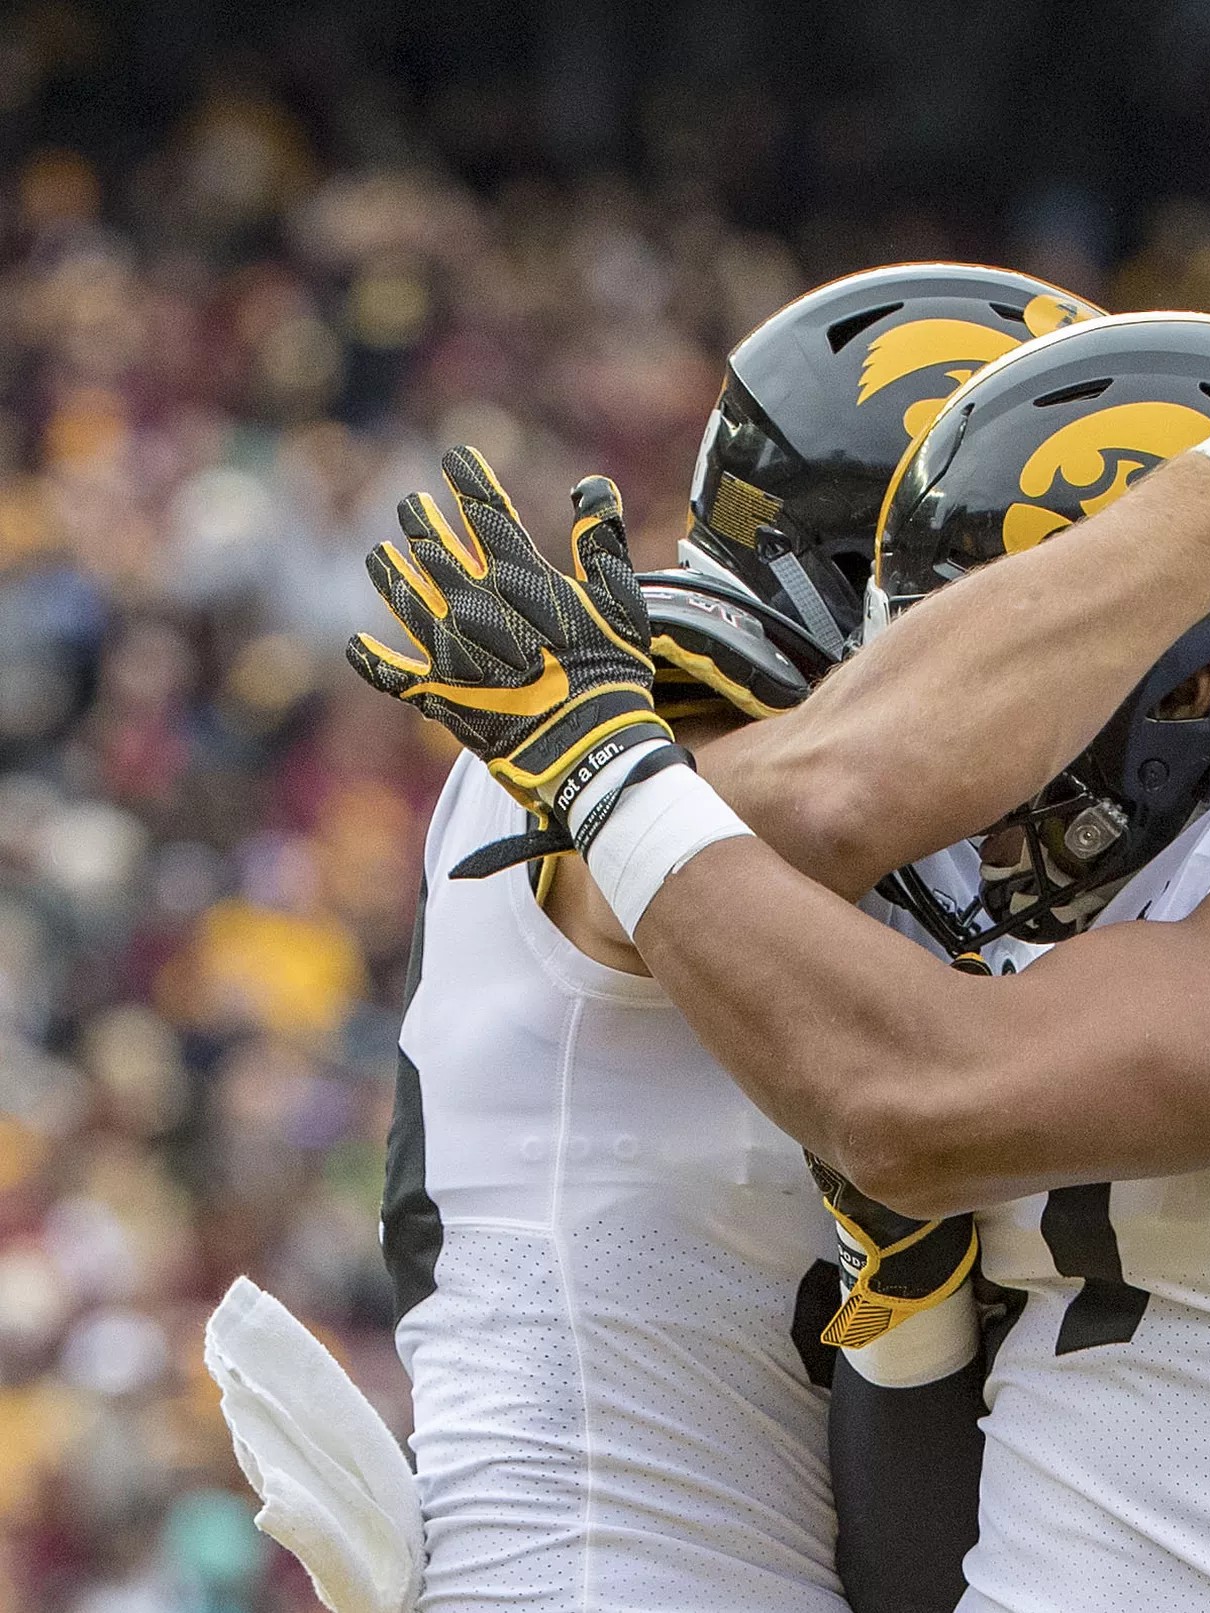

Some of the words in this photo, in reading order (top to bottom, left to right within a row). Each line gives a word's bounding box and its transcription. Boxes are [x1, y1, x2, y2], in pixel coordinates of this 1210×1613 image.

[557, 778, 581, 810] not
[578, 767, 592, 783] a
[588, 741, 624, 770] fan.
